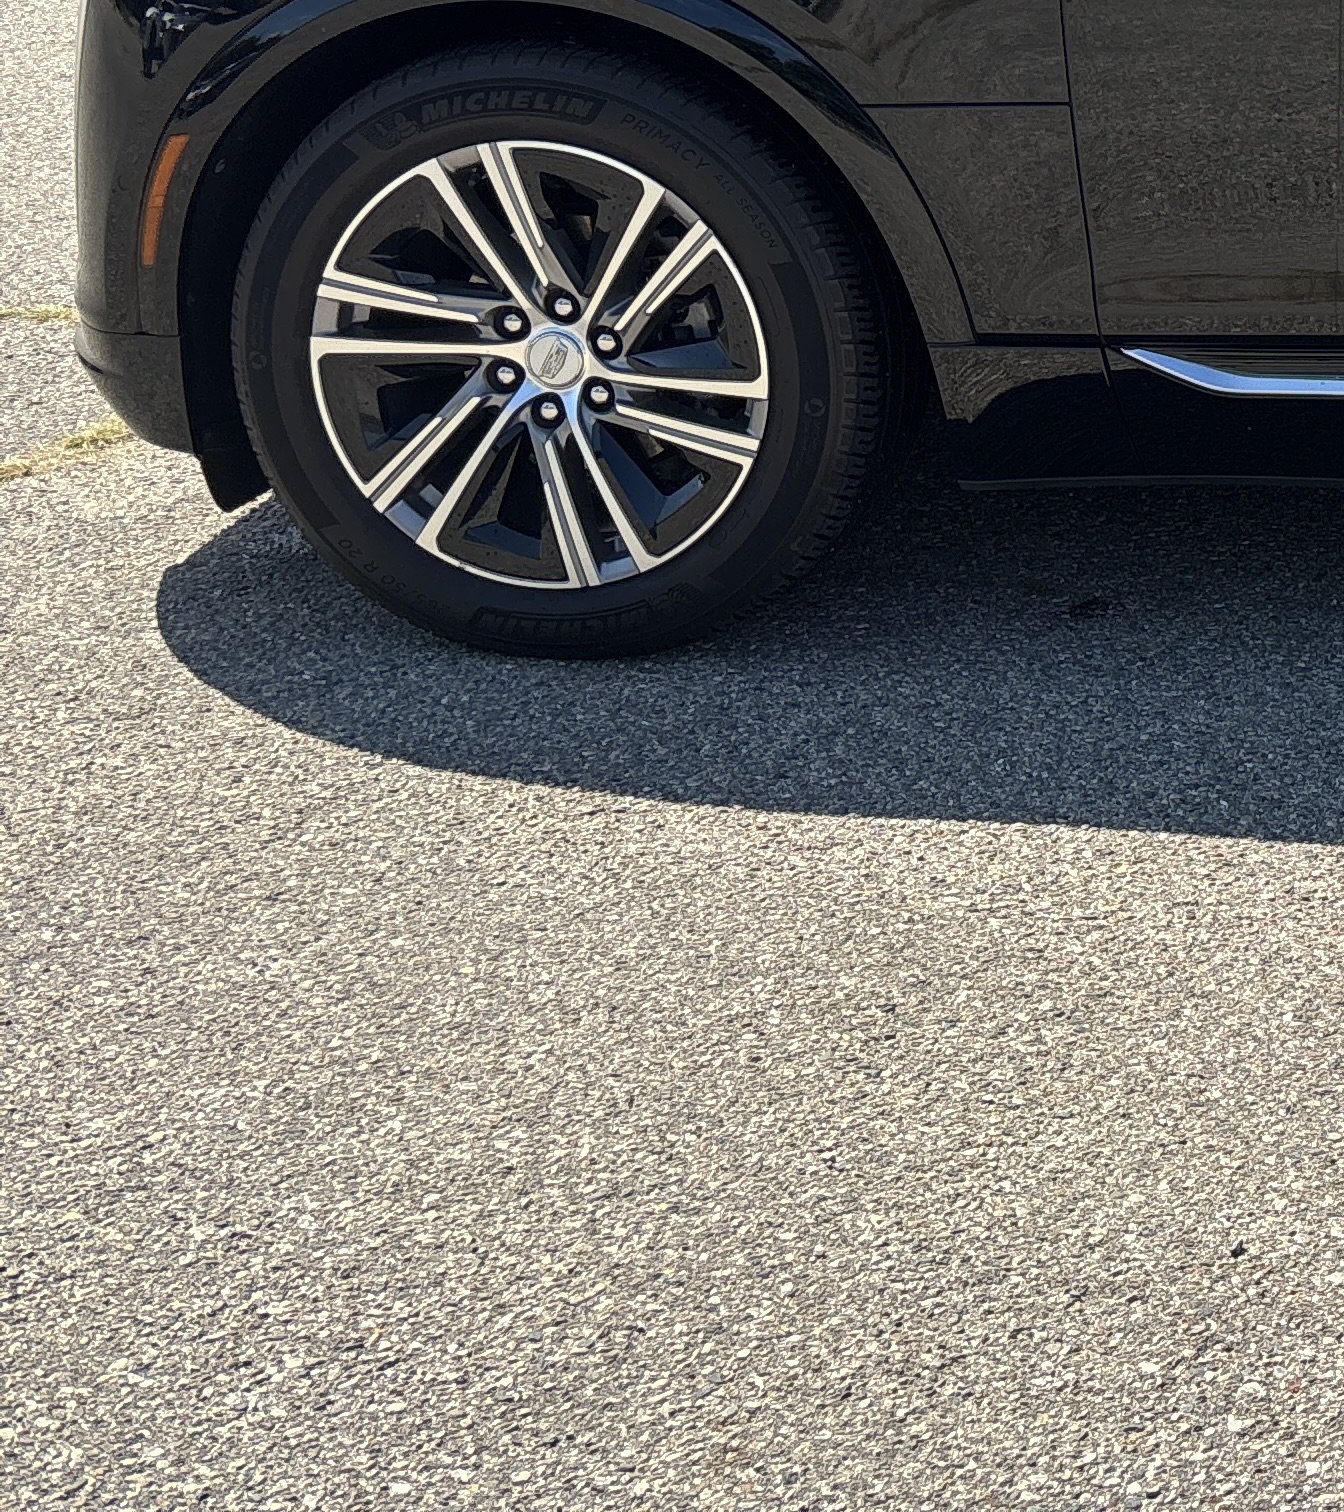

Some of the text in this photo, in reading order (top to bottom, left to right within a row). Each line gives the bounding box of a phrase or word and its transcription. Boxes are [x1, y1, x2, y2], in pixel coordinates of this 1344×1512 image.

[421, 90, 595, 123] MICHELIN
[620, 113, 779, 249] PRIMACY ALL SEASON
